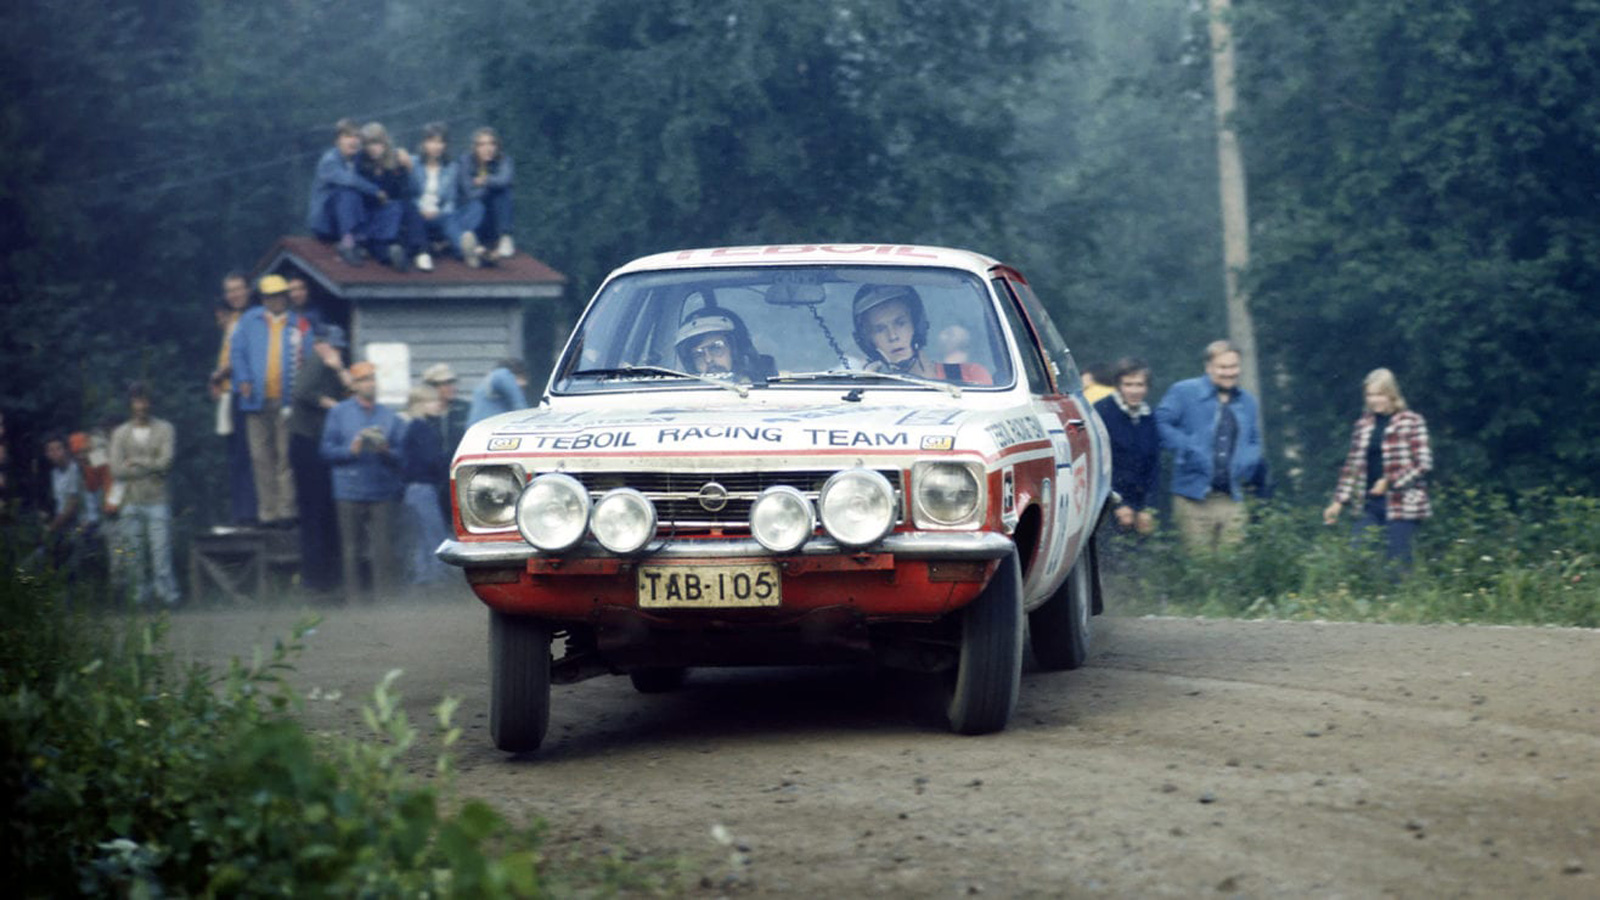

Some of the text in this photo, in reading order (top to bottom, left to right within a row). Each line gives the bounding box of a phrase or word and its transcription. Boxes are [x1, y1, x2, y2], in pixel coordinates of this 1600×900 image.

[535, 426, 908, 449] TEBOIL RACING TEAM
[645, 572, 772, 600] TAB-105
